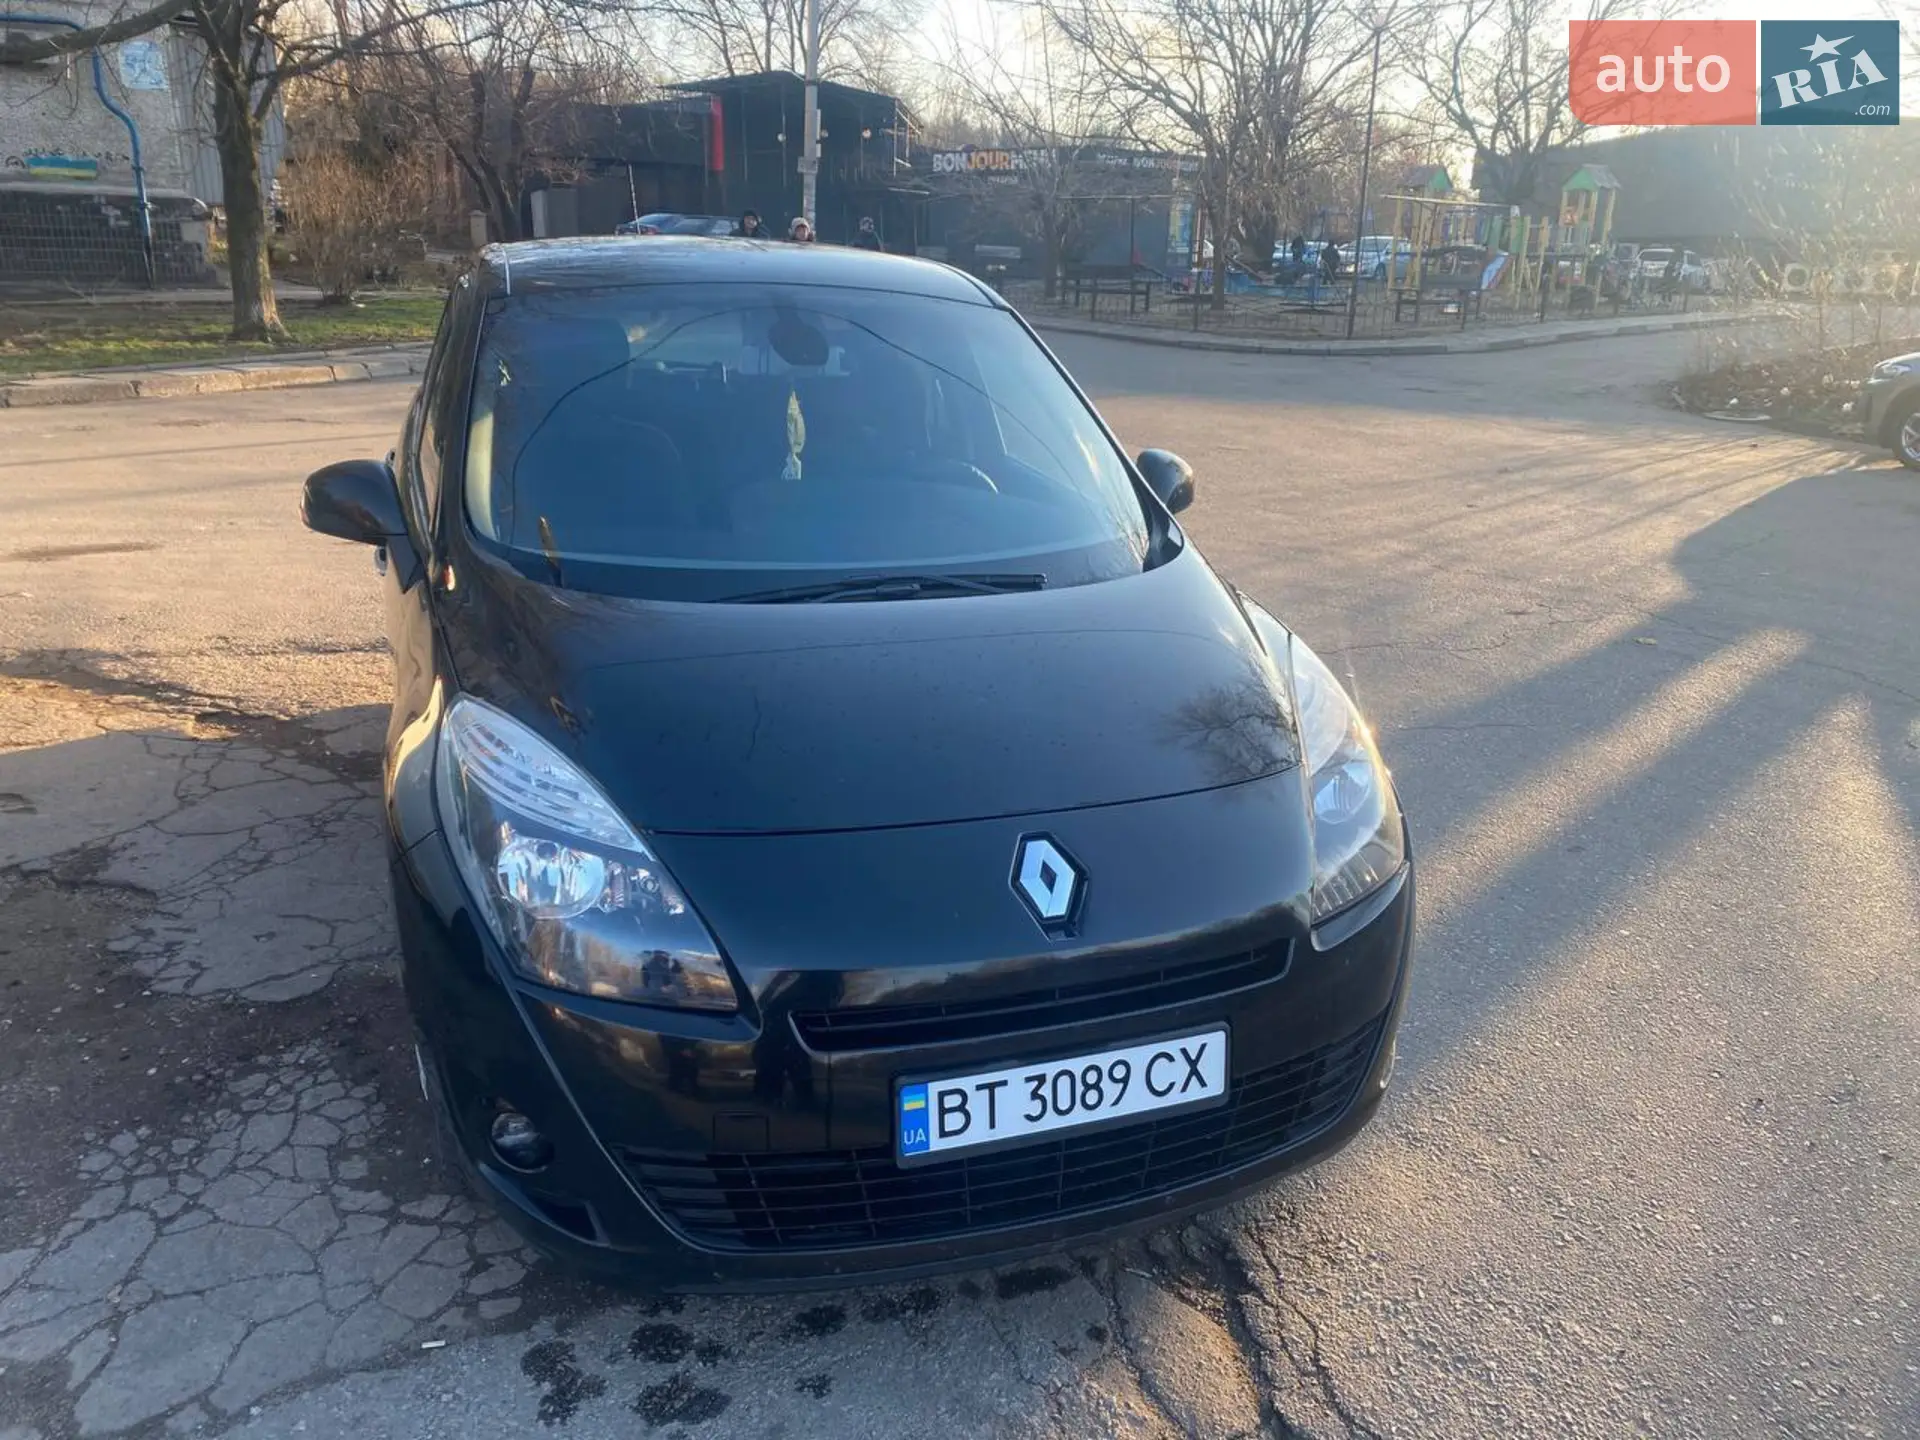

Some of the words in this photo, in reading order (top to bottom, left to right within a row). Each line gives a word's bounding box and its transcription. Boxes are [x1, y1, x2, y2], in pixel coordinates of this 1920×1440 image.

[937, 1079, 1008, 1139] BT
[1023, 1058, 1132, 1123] 3089
[1144, 1042, 1209, 1098] CX
[903, 1126, 927, 1146] UA
